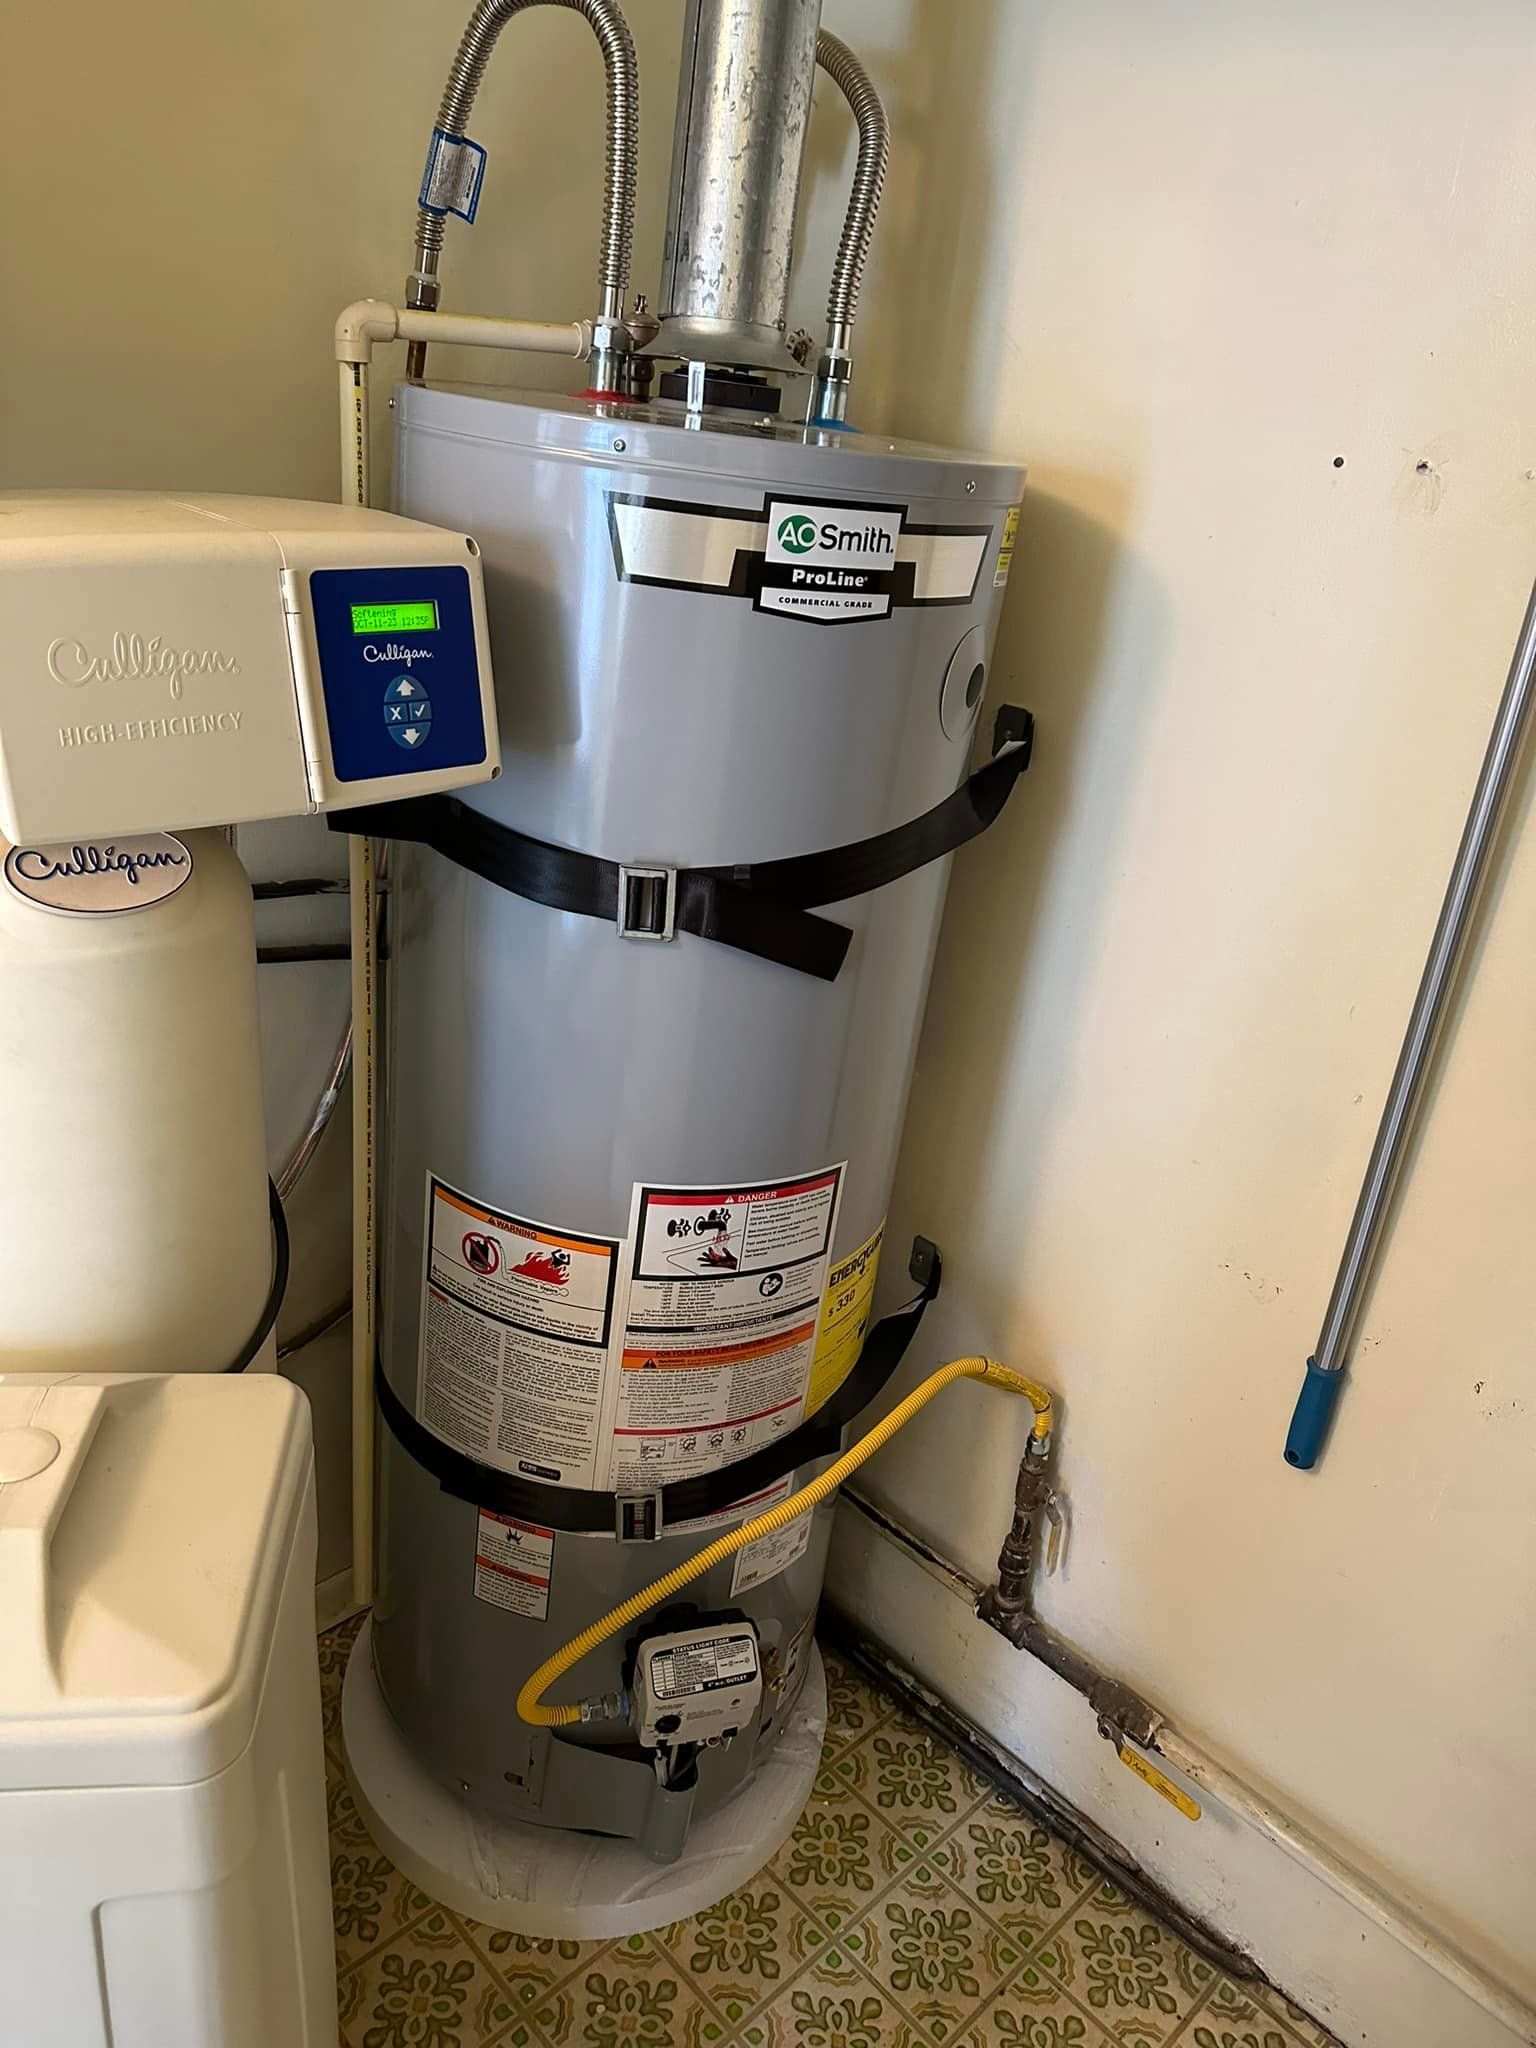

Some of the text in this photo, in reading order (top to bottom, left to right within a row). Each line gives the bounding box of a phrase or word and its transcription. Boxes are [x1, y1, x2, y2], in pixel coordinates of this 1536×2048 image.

[778, 596, 841, 607] COMMERCIAL
[352, 608, 397, 619] Softening
[58, 711, 243, 748] HIGH-EFFICIENCY
[15, 846, 184, 884] Culligan
[738, 1191, 777, 1203] DANGER
[496, 1219, 537, 1240] WARNING
[836, 1289, 855, 1312] 330
[672, 1637, 731, 1653] STATUS LIGHT CODE
[726, 1674, 747, 1684] OUTLET
